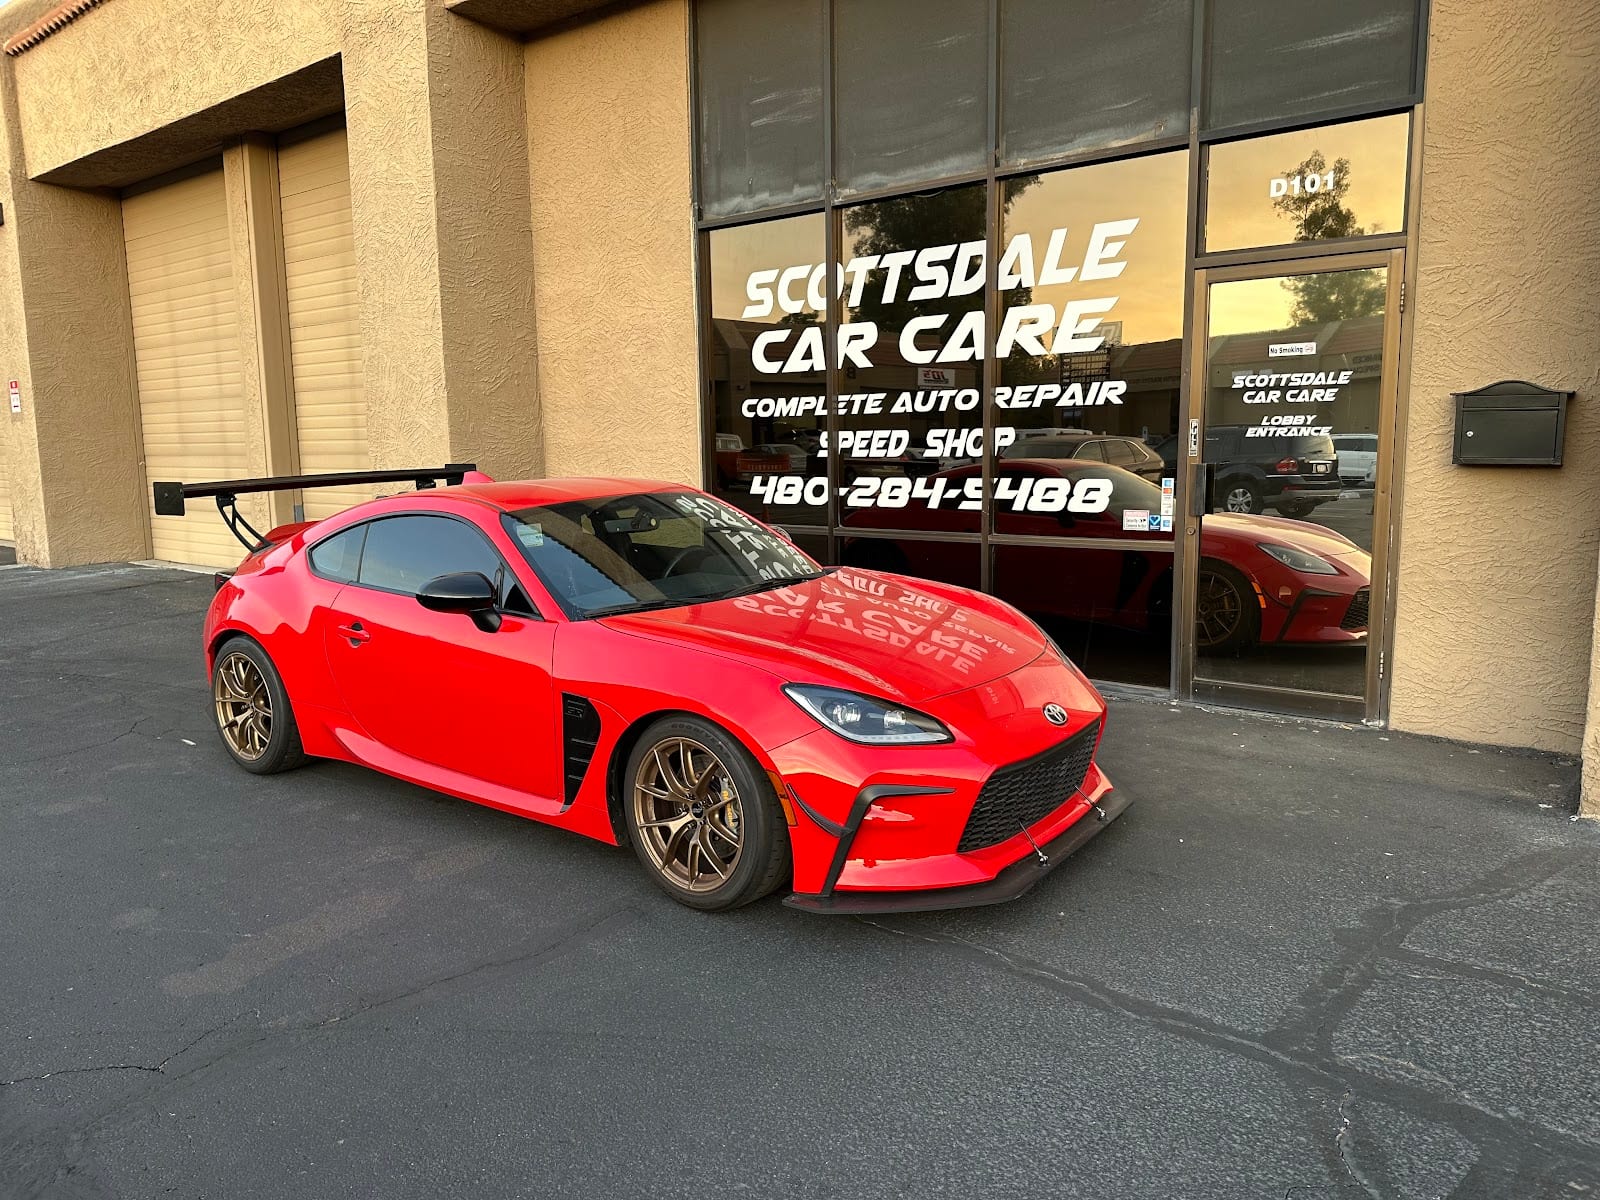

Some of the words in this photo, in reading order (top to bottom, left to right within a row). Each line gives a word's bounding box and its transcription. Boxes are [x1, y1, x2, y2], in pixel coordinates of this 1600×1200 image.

[1269, 170, 1335, 198] D101
[741, 217, 1140, 320] SCOTTSDALE
[751, 321, 878, 374] CAR
[899, 296, 1120, 364] CARE
[1279, 346, 1304, 355] Smoking
[1232, 370, 1354, 388] SCOTTSDALE
[741, 393, 888, 419] COMPLETE
[890, 388, 980, 415] AUTO
[993, 380, 1127, 409] REPAIR
[1242, 390, 1280, 404] CAR
[1285, 388, 1339, 403] CARE
[1245, 426, 1333, 438] ENTRANCE
[1261, 414, 1316, 426] LOBBY
[817, 429, 909, 458] SPEED
[923, 427, 1016, 457] SHOP
[749, 475, 1114, 513] 480-284-5488
